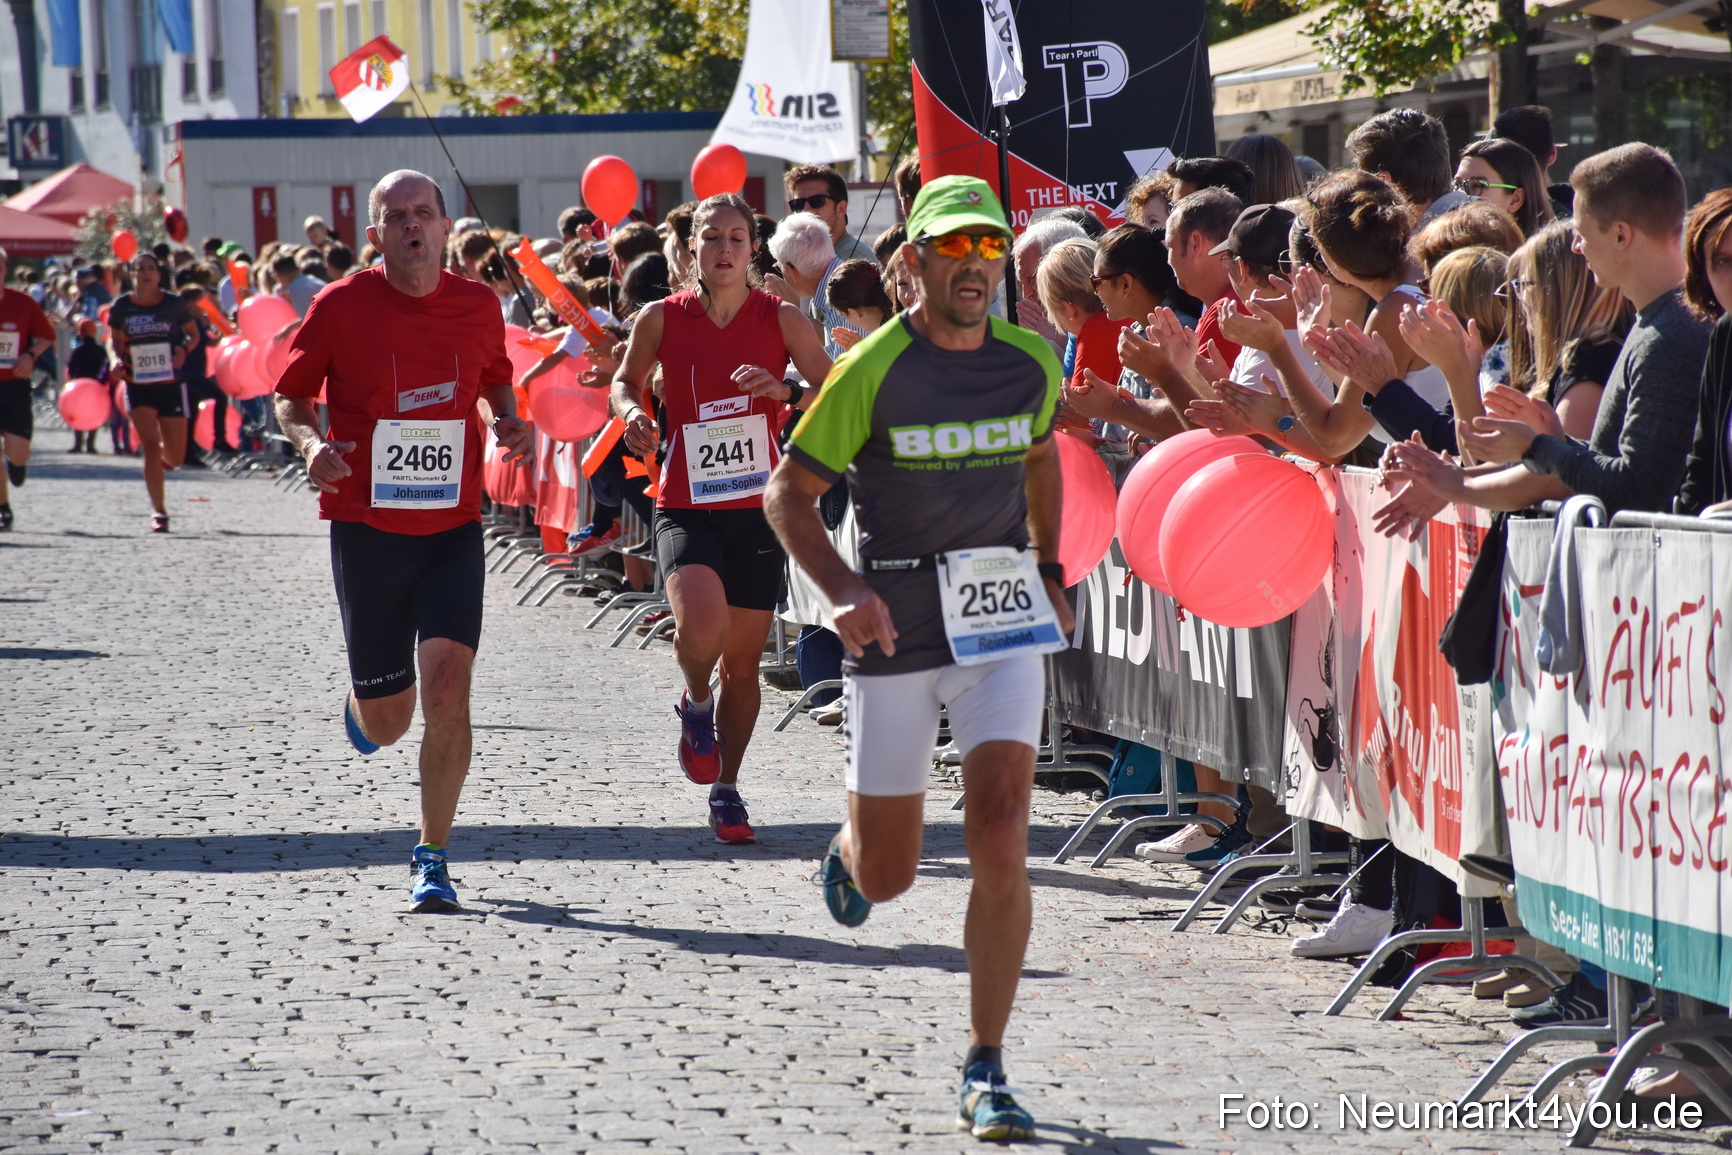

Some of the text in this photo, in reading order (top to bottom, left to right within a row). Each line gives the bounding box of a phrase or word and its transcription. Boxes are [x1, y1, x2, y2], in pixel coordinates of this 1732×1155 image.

[1026, 182, 1118, 206] THE NEXT
[551, 287, 590, 332] DEHN
[128, 322, 171, 335] DESIGN
[138, 354, 166, 368] 2018
[414, 390, 440, 403] DEHN
[712, 402, 735, 413] DEHN
[401, 428, 441, 438] BOCK
[708, 424, 744, 437] BOCK
[890, 417, 1033, 458] BOCK
[387, 445, 452, 471] 2466
[699, 438, 754, 469] 2441
[726, 467, 749, 475] Neumarkt
[946, 460, 961, 471] by
[965, 456, 1000, 468] smart
[393, 487, 445, 498] Johannes
[702, 476, 763, 494] Anne-Sophie
[959, 579, 1032, 618] 2526
[978, 630, 1035, 651] Reinhold
[385, 668, 407, 681] TEAM
[1618, 751, 1732, 873] BESSE
